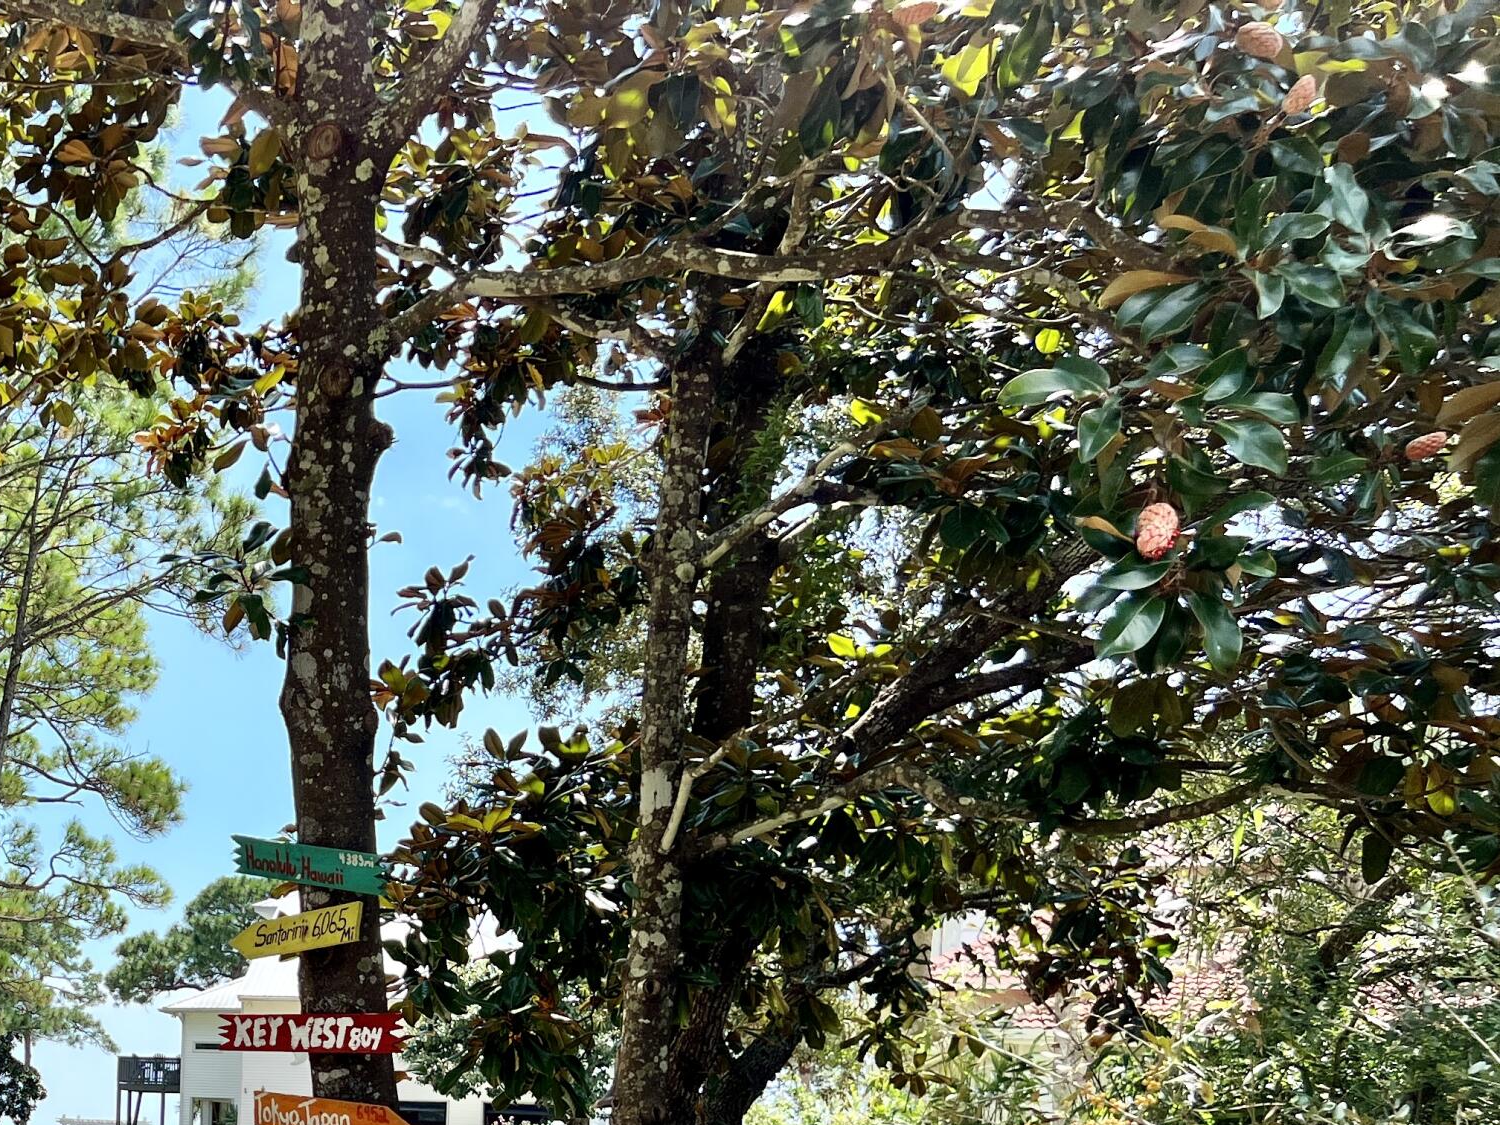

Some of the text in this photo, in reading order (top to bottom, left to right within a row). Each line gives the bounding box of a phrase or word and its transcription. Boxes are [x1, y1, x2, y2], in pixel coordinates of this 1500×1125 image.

[301, 856, 344, 885] Hawaii
[233, 1016, 284, 1048] KEY
[288, 1016, 354, 1050] WEST
